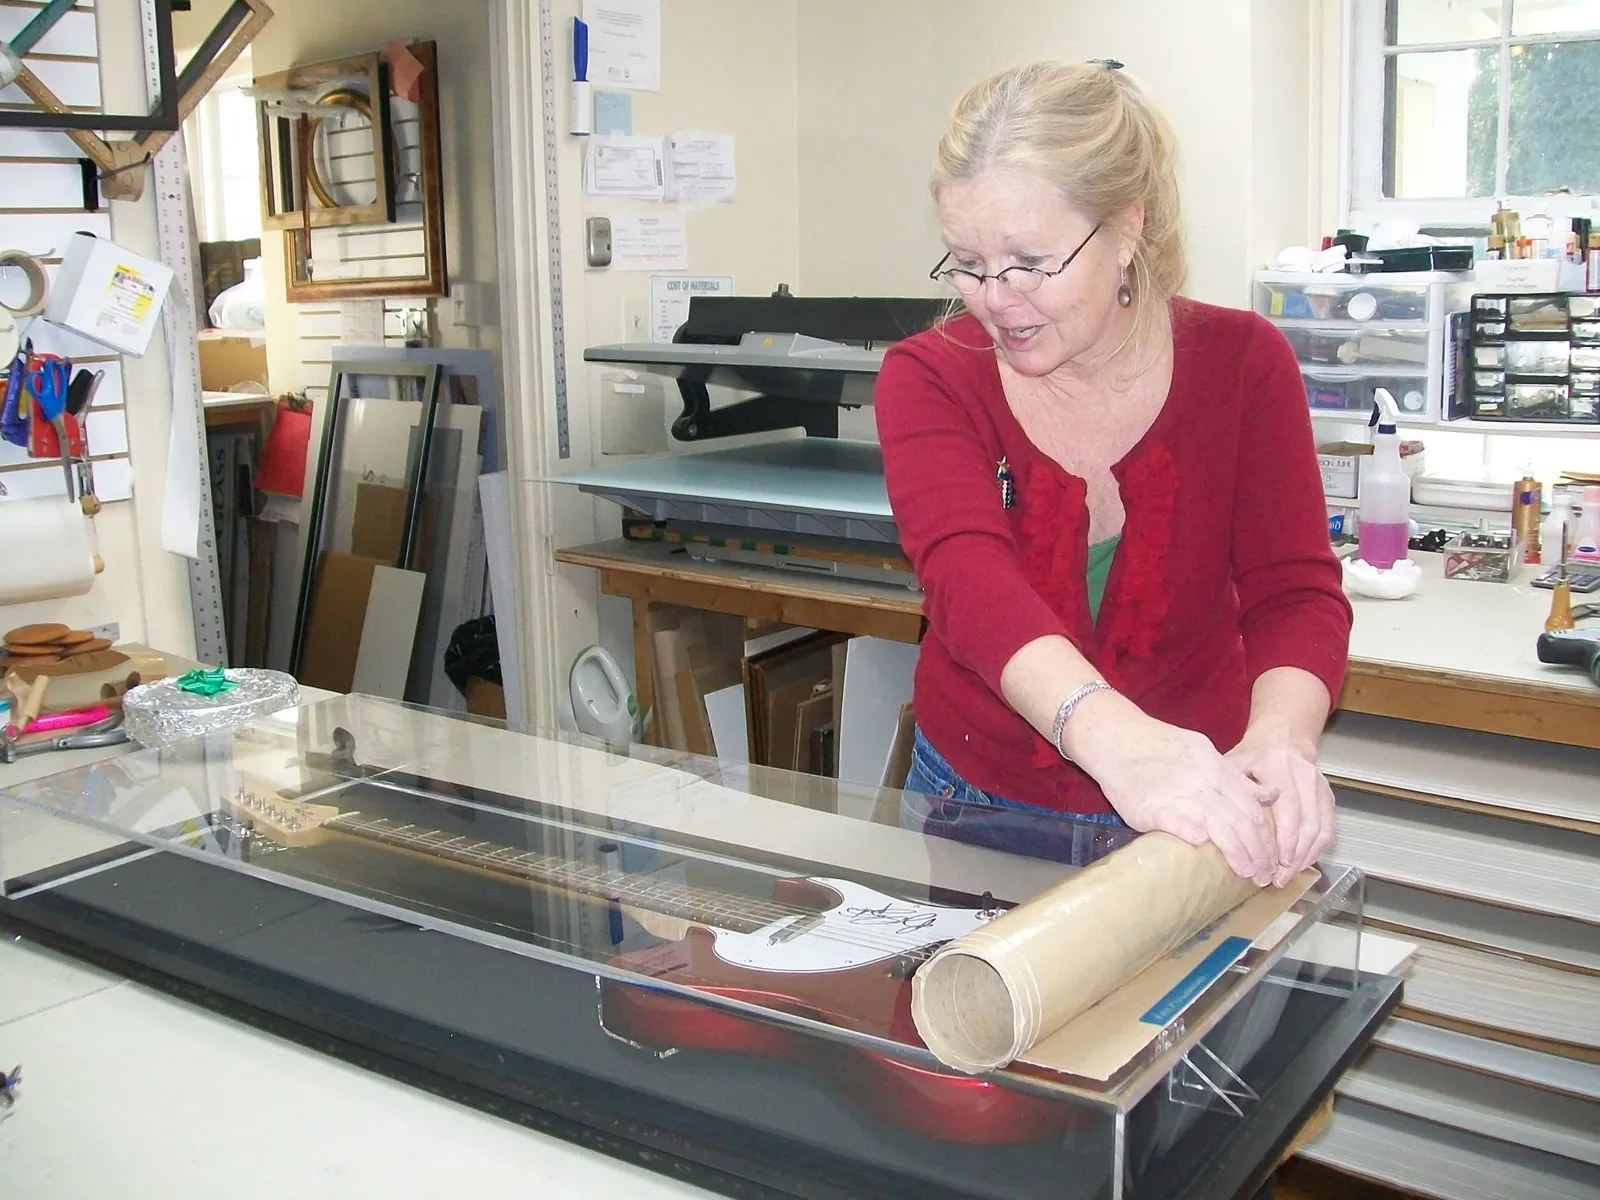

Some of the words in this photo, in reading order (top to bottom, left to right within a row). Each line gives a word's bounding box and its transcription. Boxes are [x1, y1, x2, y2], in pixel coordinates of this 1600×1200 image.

[667, 280, 681, 291] COST
[682, 280, 690, 291] OF
[691, 280, 720, 291] MATERIALS
